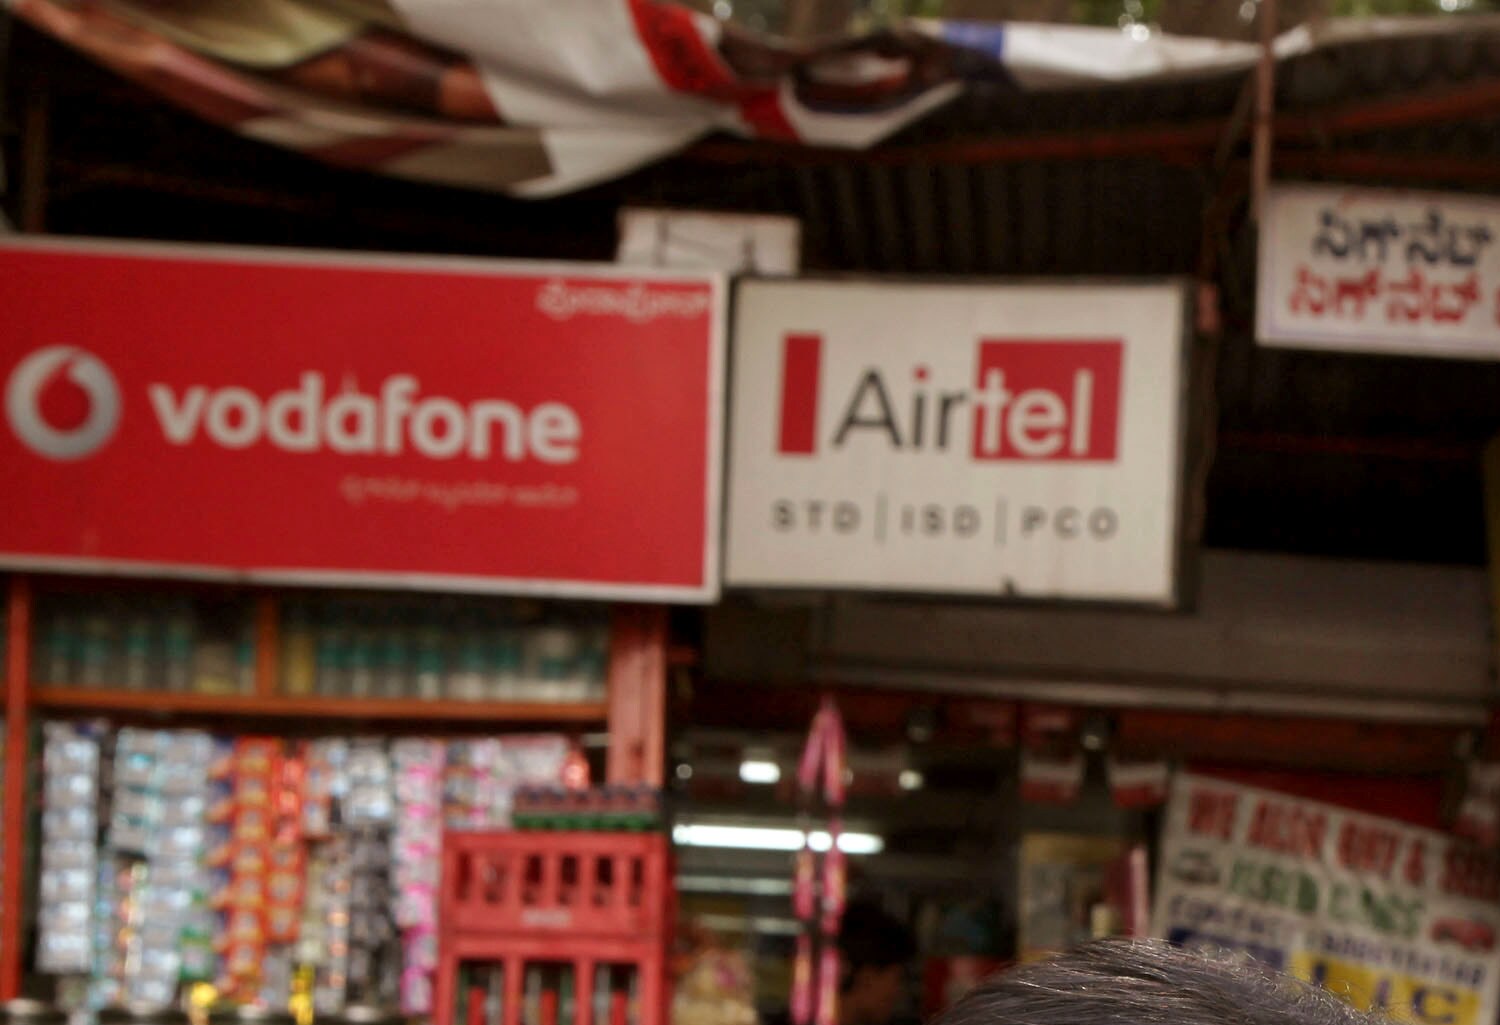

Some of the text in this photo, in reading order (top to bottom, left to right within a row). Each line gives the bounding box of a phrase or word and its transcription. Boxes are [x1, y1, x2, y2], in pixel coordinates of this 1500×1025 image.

[147, 370, 582, 465] vodafone
[830, 365, 1094, 458] Airtel
[771, 499, 1120, 542] STD ISD PCO
